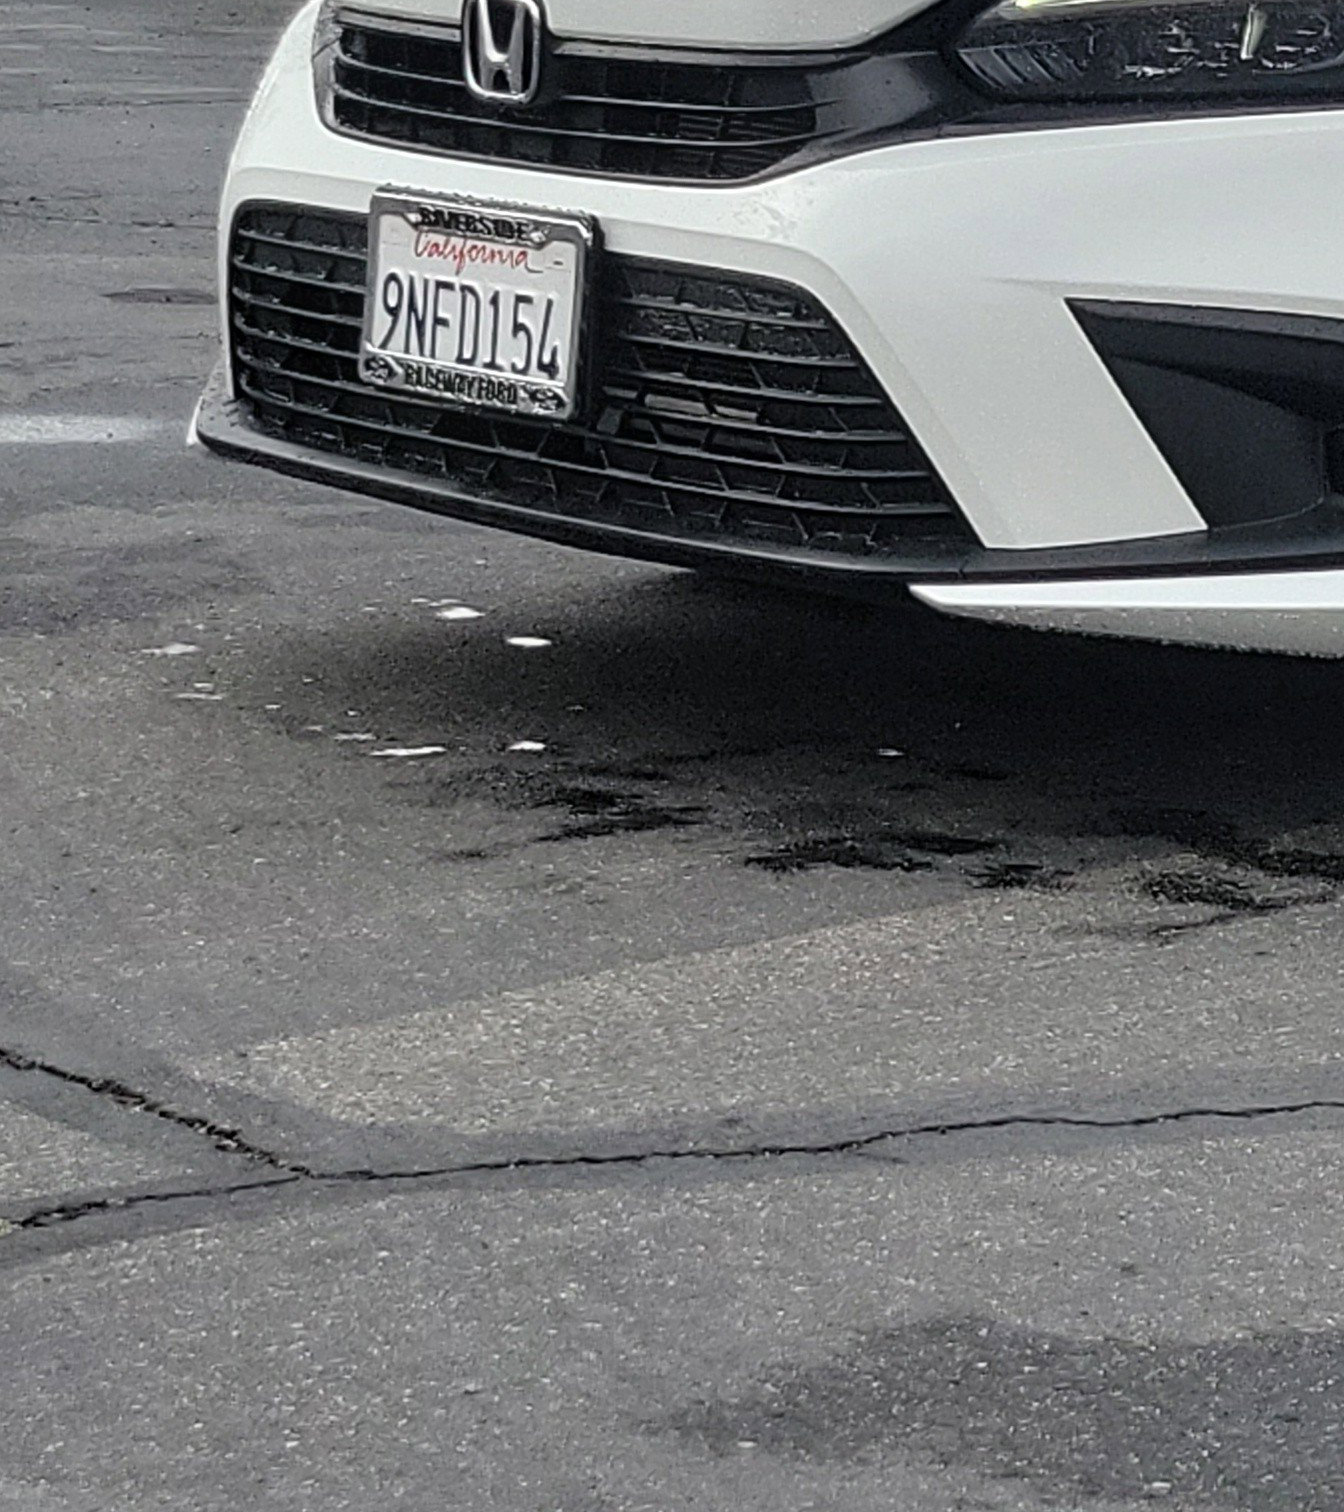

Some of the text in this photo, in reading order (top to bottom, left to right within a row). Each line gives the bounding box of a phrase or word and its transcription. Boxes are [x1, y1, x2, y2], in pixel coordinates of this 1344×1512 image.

[419, 205, 533, 240] RIVERSIDE
[414, 229, 543, 276] California
[378, 271, 560, 381] 9NFD154
[476, 374, 518, 405] FORD
